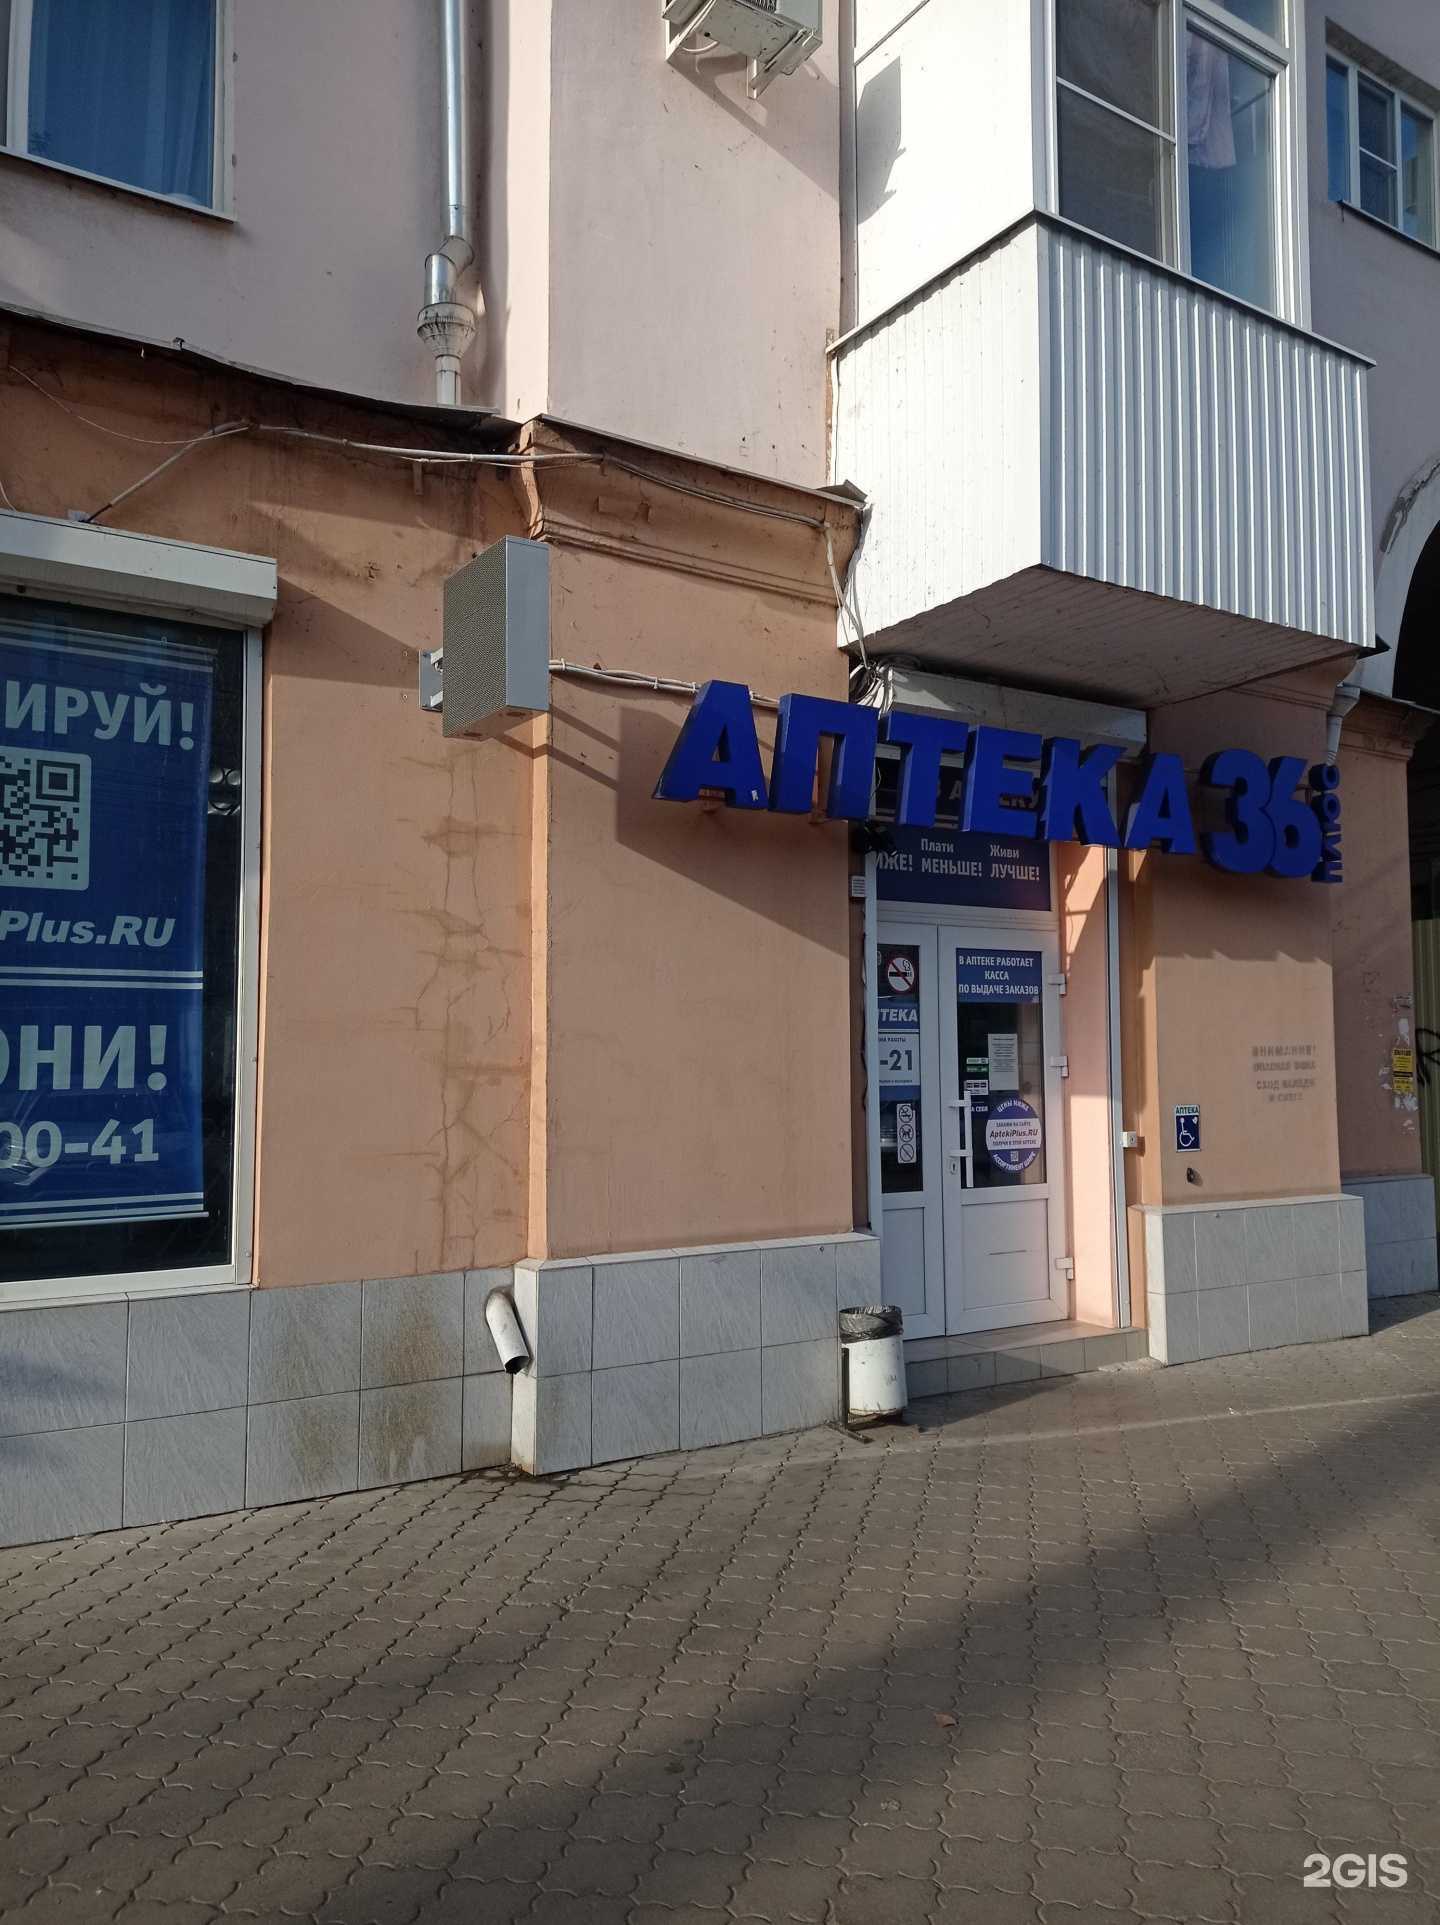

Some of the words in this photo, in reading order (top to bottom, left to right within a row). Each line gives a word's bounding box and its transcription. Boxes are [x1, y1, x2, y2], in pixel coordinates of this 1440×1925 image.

[5, 680, 194, 750] ИРУЙ!
[653, 680, 1198, 854] АПТЕКА
[1200, 748, 1322, 879] 36
[921, 838, 954, 853] Плати
[990, 845, 1020, 859] Живи
[921, 858, 982, 877] МЕНЬШЕ!
[990, 864, 1040, 881] ЛУЧШЕ!
[0, 910, 176, 947] Plus.RU
[959, 956, 964, 965] В
[966, 956, 995, 966] АПТЕКЕ
[997, 957, 1034, 967] РАБОТАЕТ
[985, 971, 1009, 980] КАССА
[959, 984, 969, 993] ПО
[971, 984, 1003, 995] ВЫДАЧЕ
[1005, 985, 1039, 995] ЗАКАЗОВ
[879, 1008, 918, 1022] ТЕКА
[0, 1025, 167, 1091] НИ!
[1176, 1106, 1199, 1115] АПТЕКА
